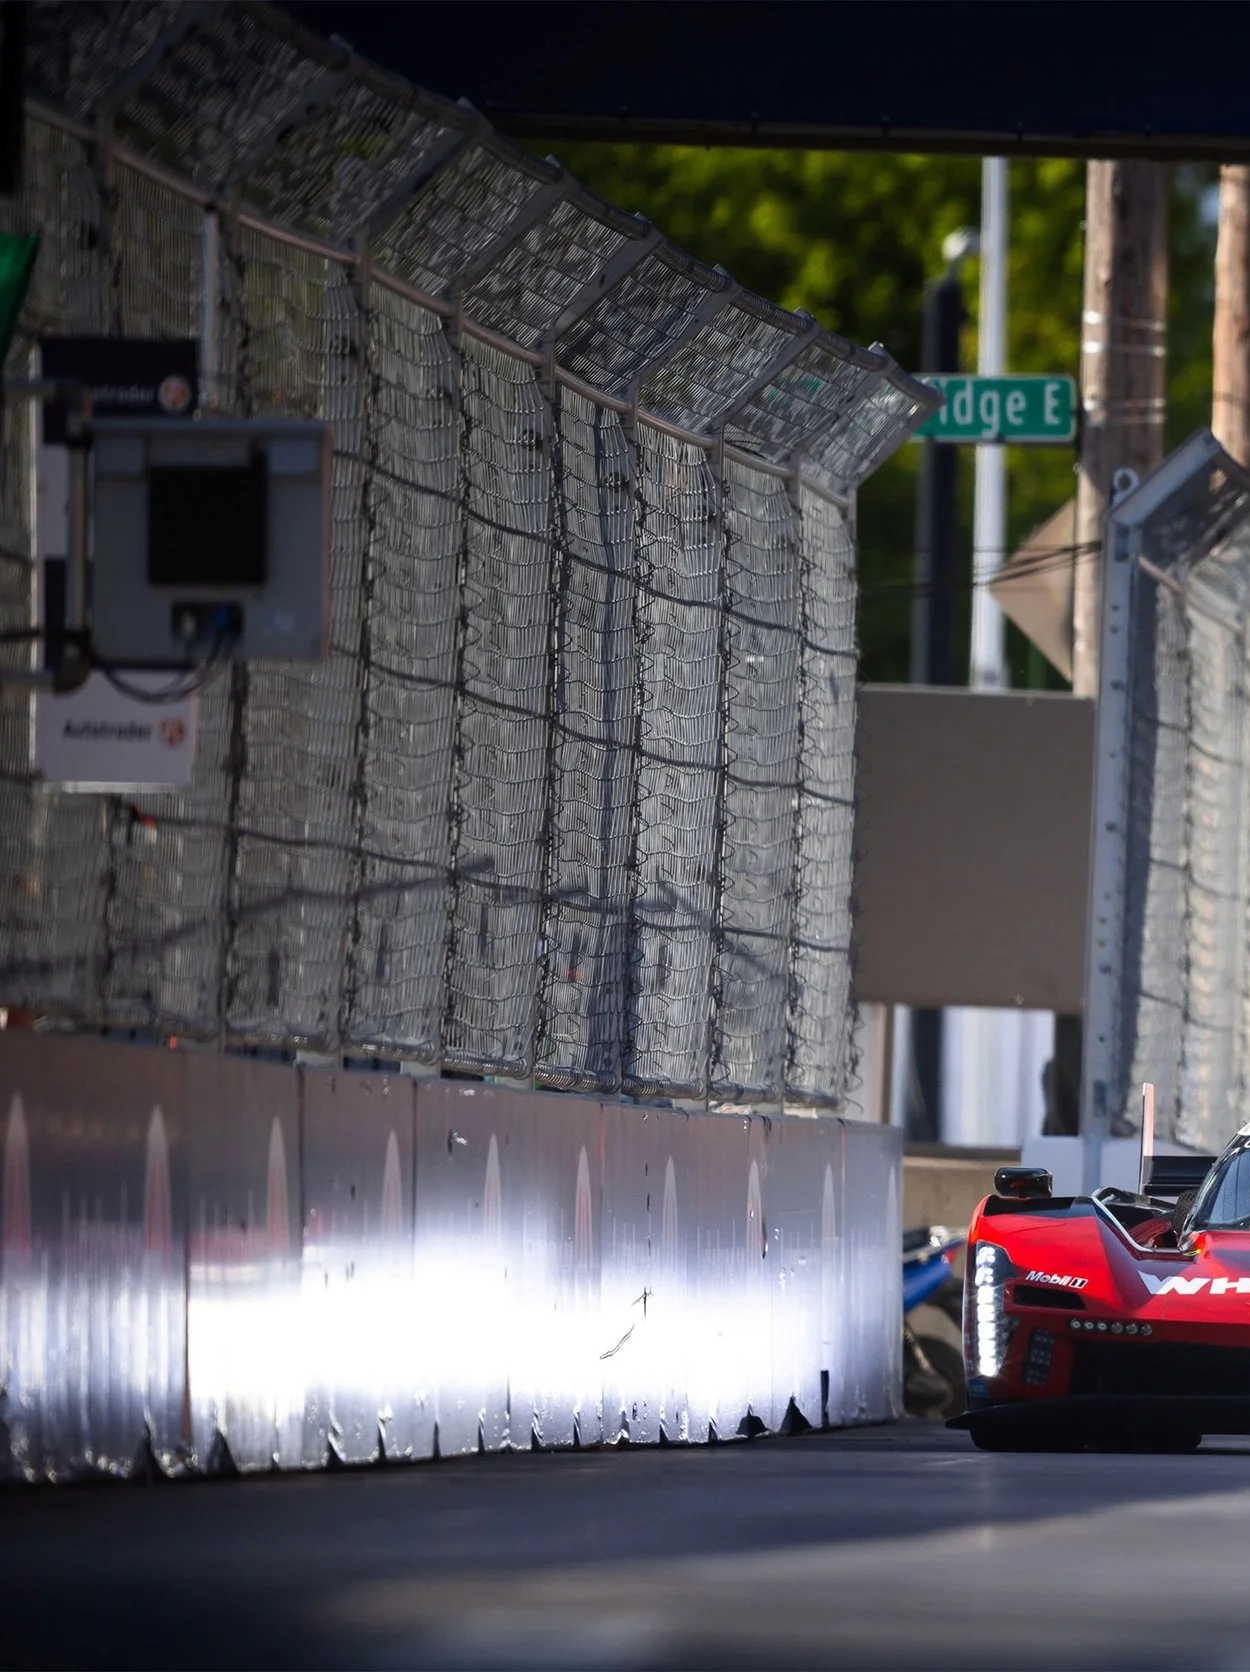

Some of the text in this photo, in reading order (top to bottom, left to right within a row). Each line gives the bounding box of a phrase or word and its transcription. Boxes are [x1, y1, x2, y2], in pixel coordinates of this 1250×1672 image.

[938, 378, 1062, 439] idge E
[1025, 1270, 1073, 1287] Mobil
